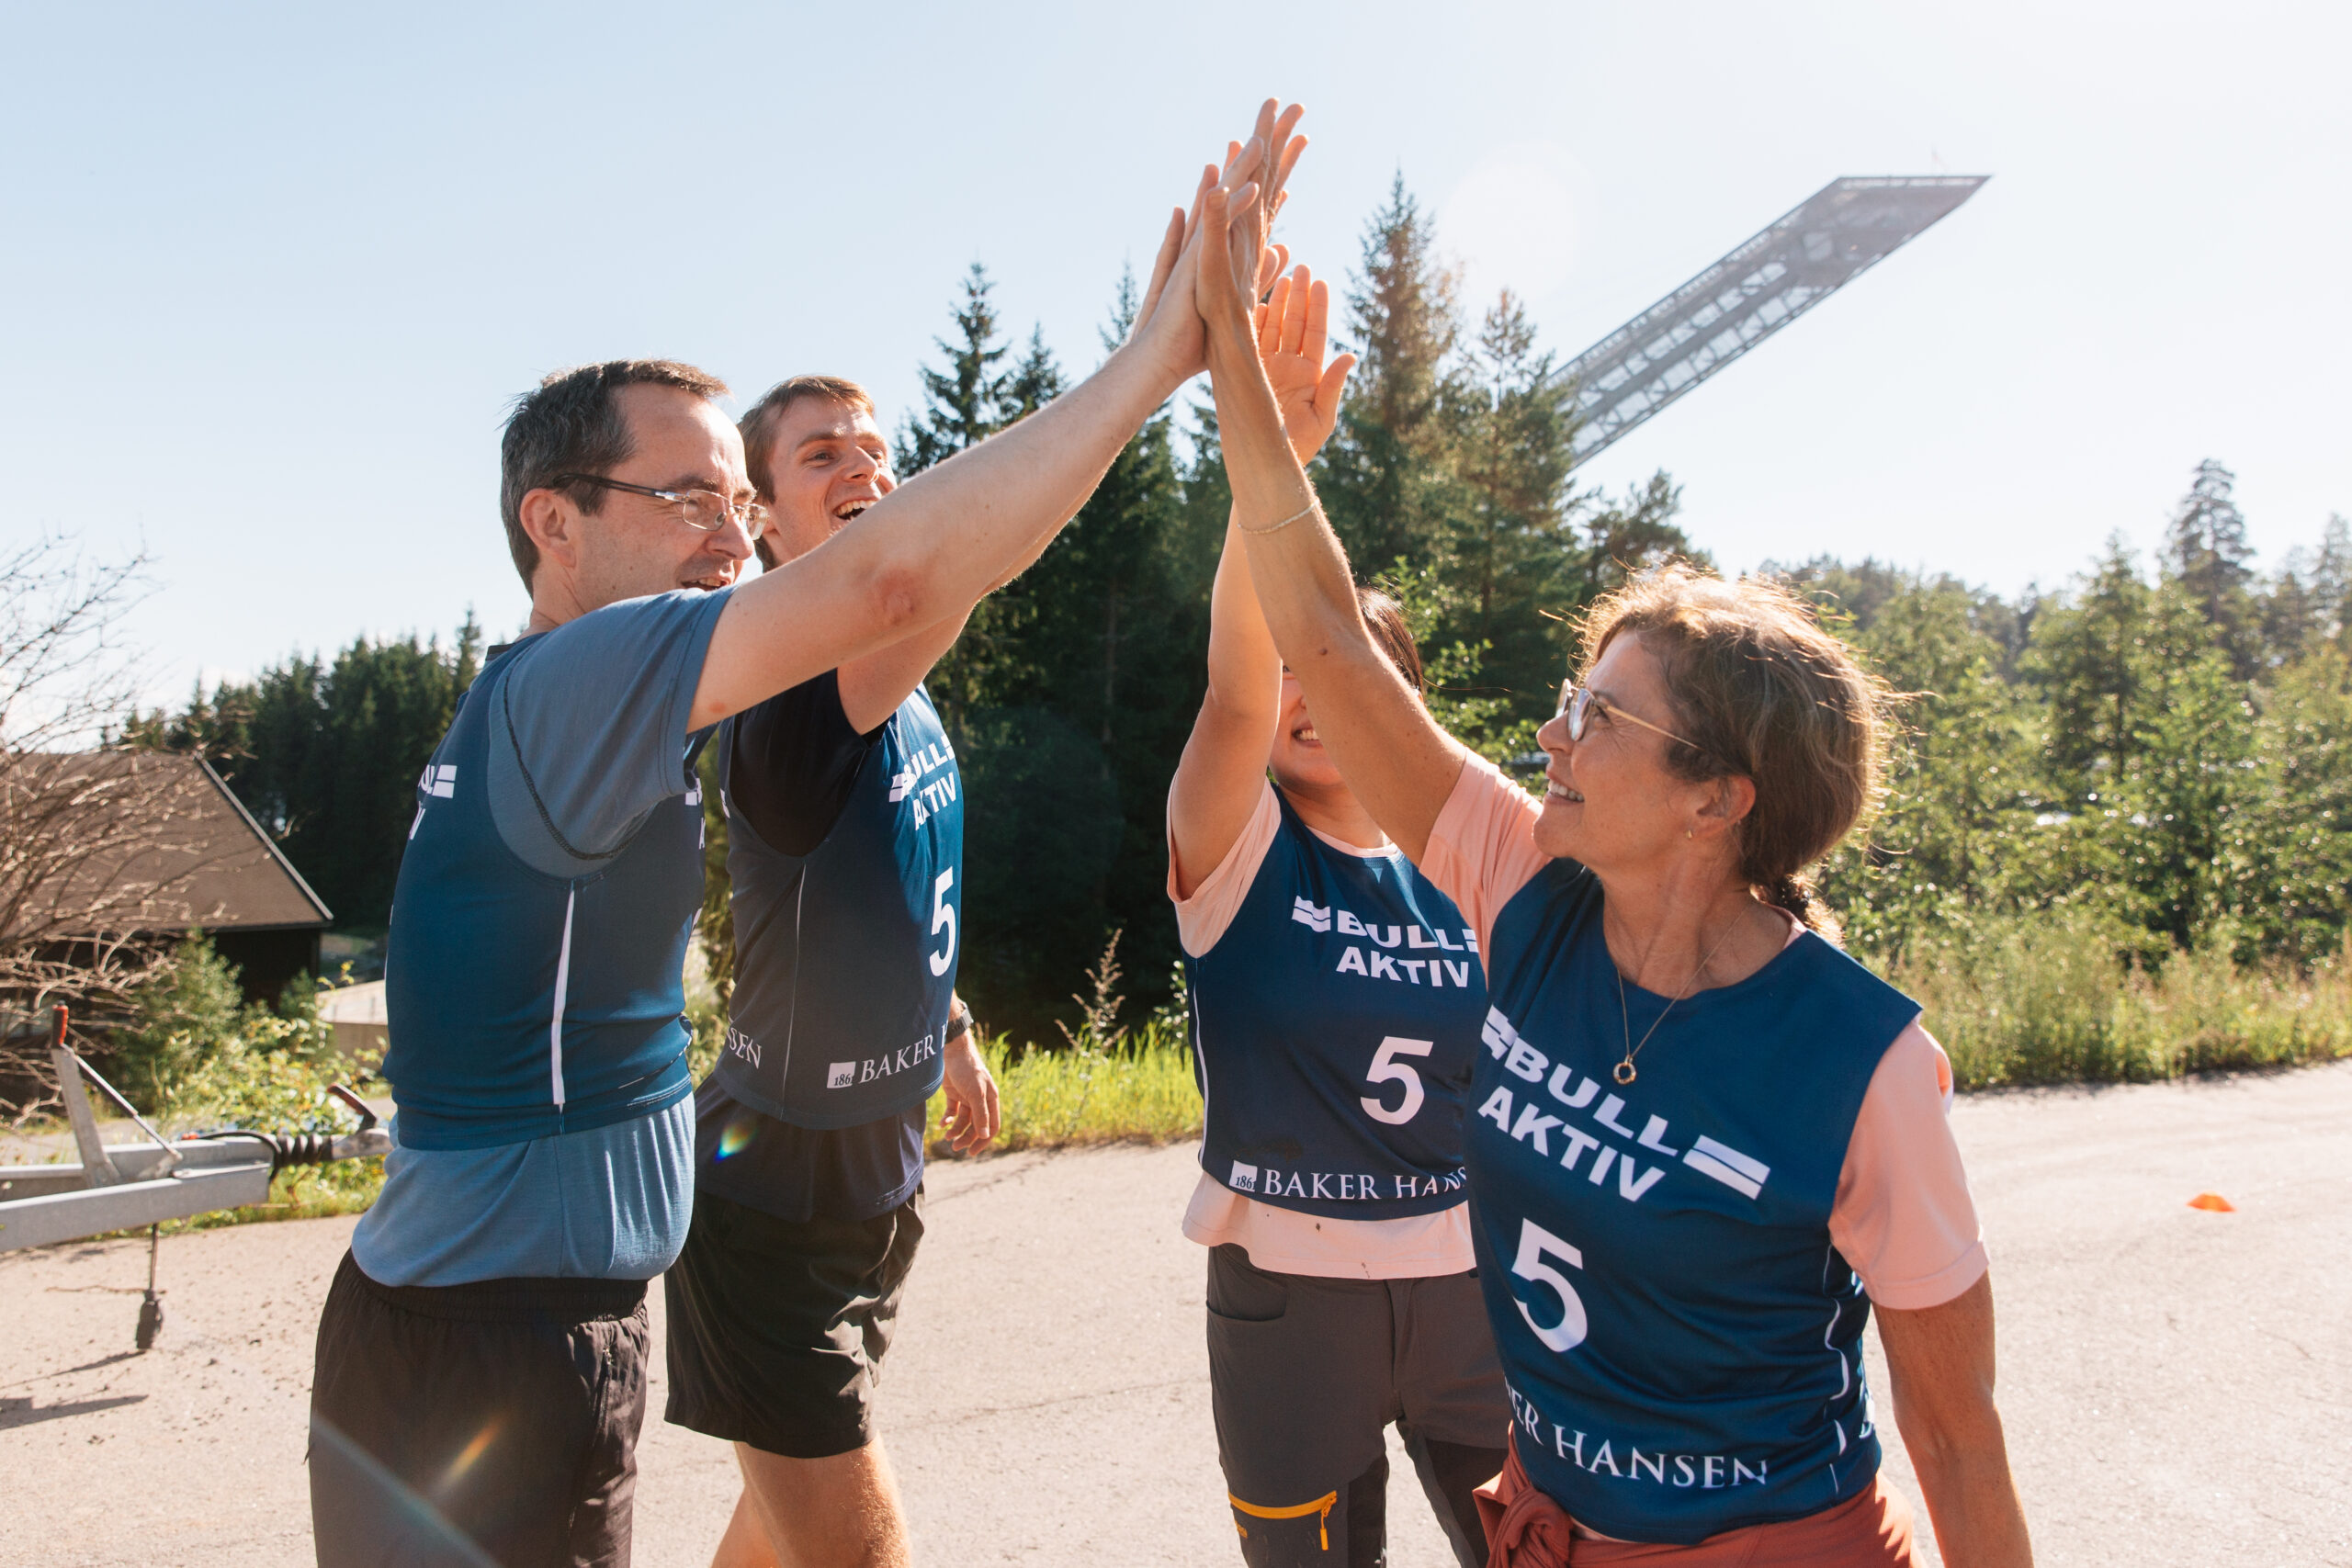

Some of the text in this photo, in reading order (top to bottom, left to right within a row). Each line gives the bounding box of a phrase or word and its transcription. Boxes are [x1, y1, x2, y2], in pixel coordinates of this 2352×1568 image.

[912, 772, 956, 831] AKTIV
[929, 865, 956, 977] 5
[1337, 909, 1465, 952] BULL
[1335, 945, 1470, 988] AKTIV
[727, 1026, 763, 1070] SEN
[858, 1034, 937, 1085] BAKER
[1360, 1036, 1434, 1125] 5
[1504, 1036, 1679, 1157] BULL
[1476, 1085, 1667, 1202] AKTIV
[1262, 1168, 1382, 1201] BAKER
[1511, 1217, 1588, 1353] 5
[1552, 1423, 1769, 1489] HANSEN
